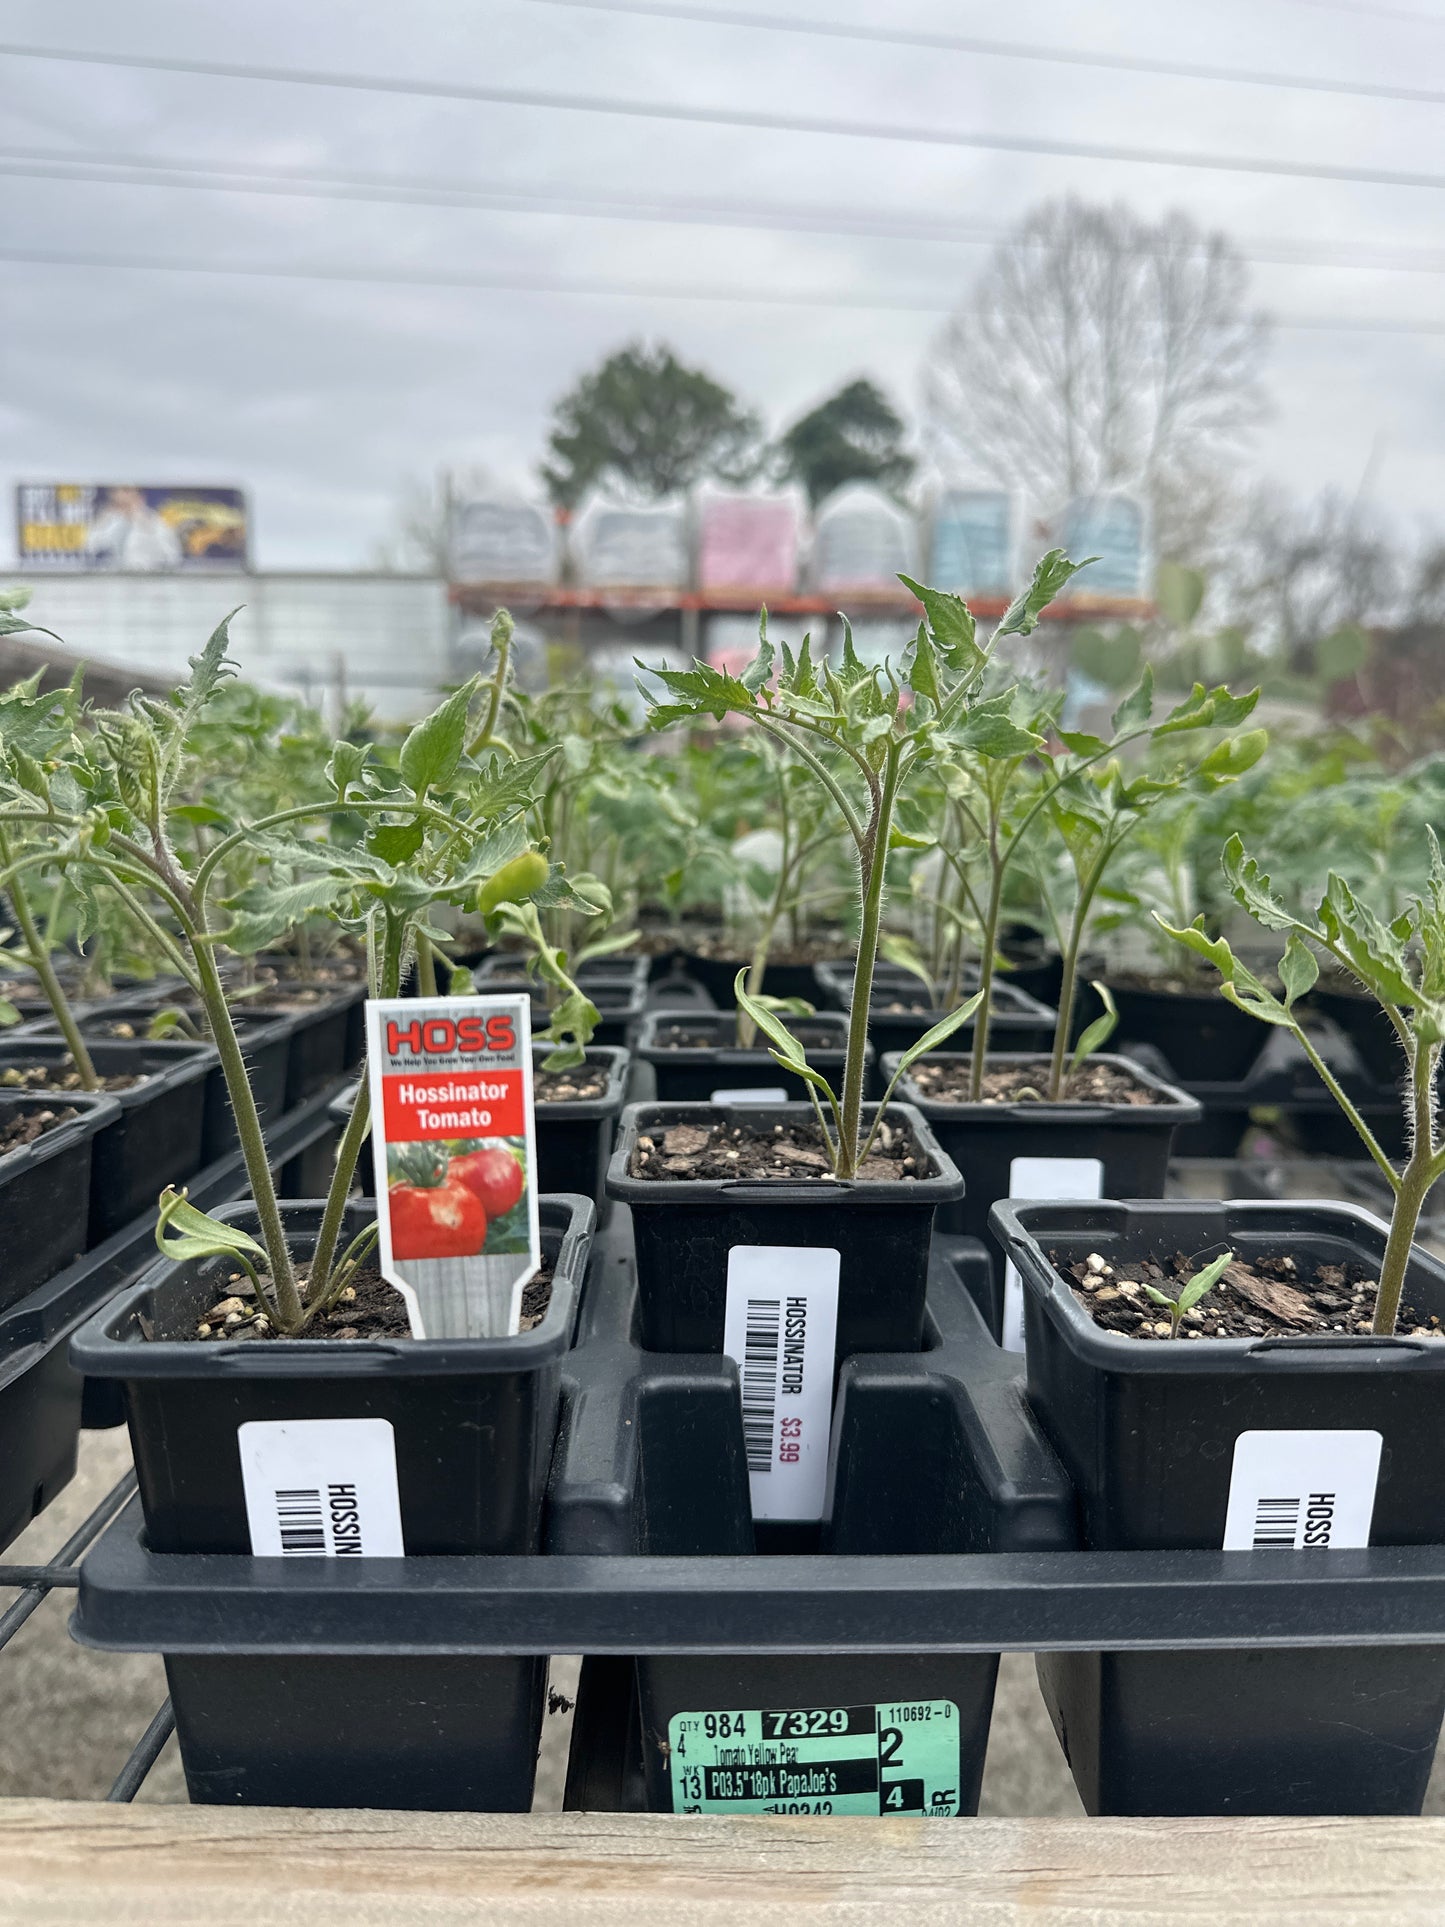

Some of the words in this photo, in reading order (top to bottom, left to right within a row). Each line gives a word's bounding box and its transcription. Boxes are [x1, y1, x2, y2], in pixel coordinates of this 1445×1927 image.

[386, 1014, 516, 1056] HOSS
[404, 1058, 422, 1067] Help
[399, 1081, 509, 1105] Hossinator
[417, 1108, 492, 1130] Tomato
[781, 1296, 807, 1394] HOSSINATOR
[779, 1417, 803, 1463] $3.99
[327, 1484, 363, 1555] HOSSIN
[680, 1721, 700, 1732] QTY
[704, 1713, 746, 1739] 984
[768, 1709, 849, 1736] 7329
[677, 1733, 686, 1757] 4
[714, 1744, 746, 1767] Tomato
[747, 1743, 778, 1766] Yellow
[880, 1727, 904, 1768] 2
[683, 1765, 700, 1776] WK
[680, 1775, 702, 1799] 13
[886, 1786, 904, 1808] 4
